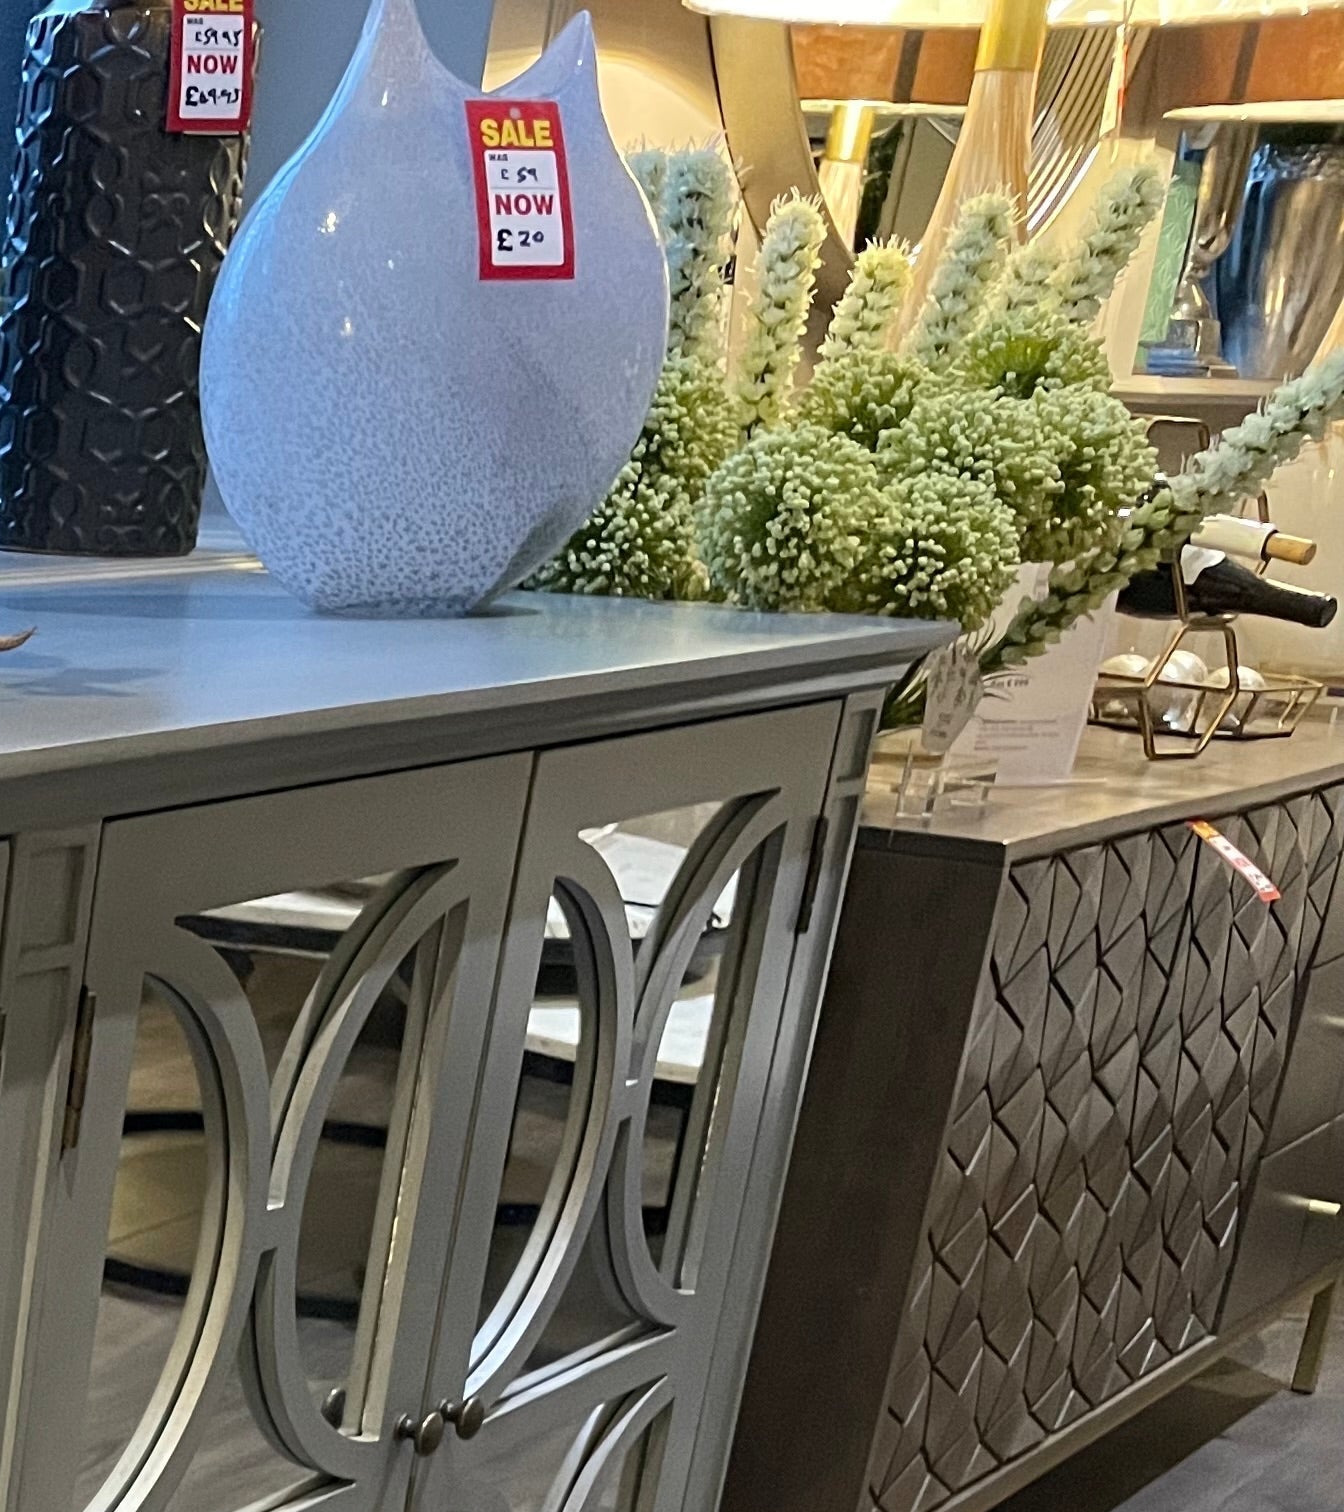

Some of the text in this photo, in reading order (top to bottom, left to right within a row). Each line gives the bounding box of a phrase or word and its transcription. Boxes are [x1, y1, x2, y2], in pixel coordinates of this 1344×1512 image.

[187, 54, 238, 74] NOW
[480, 119, 554, 147] SALE
[495, 194, 554, 216] NOW
